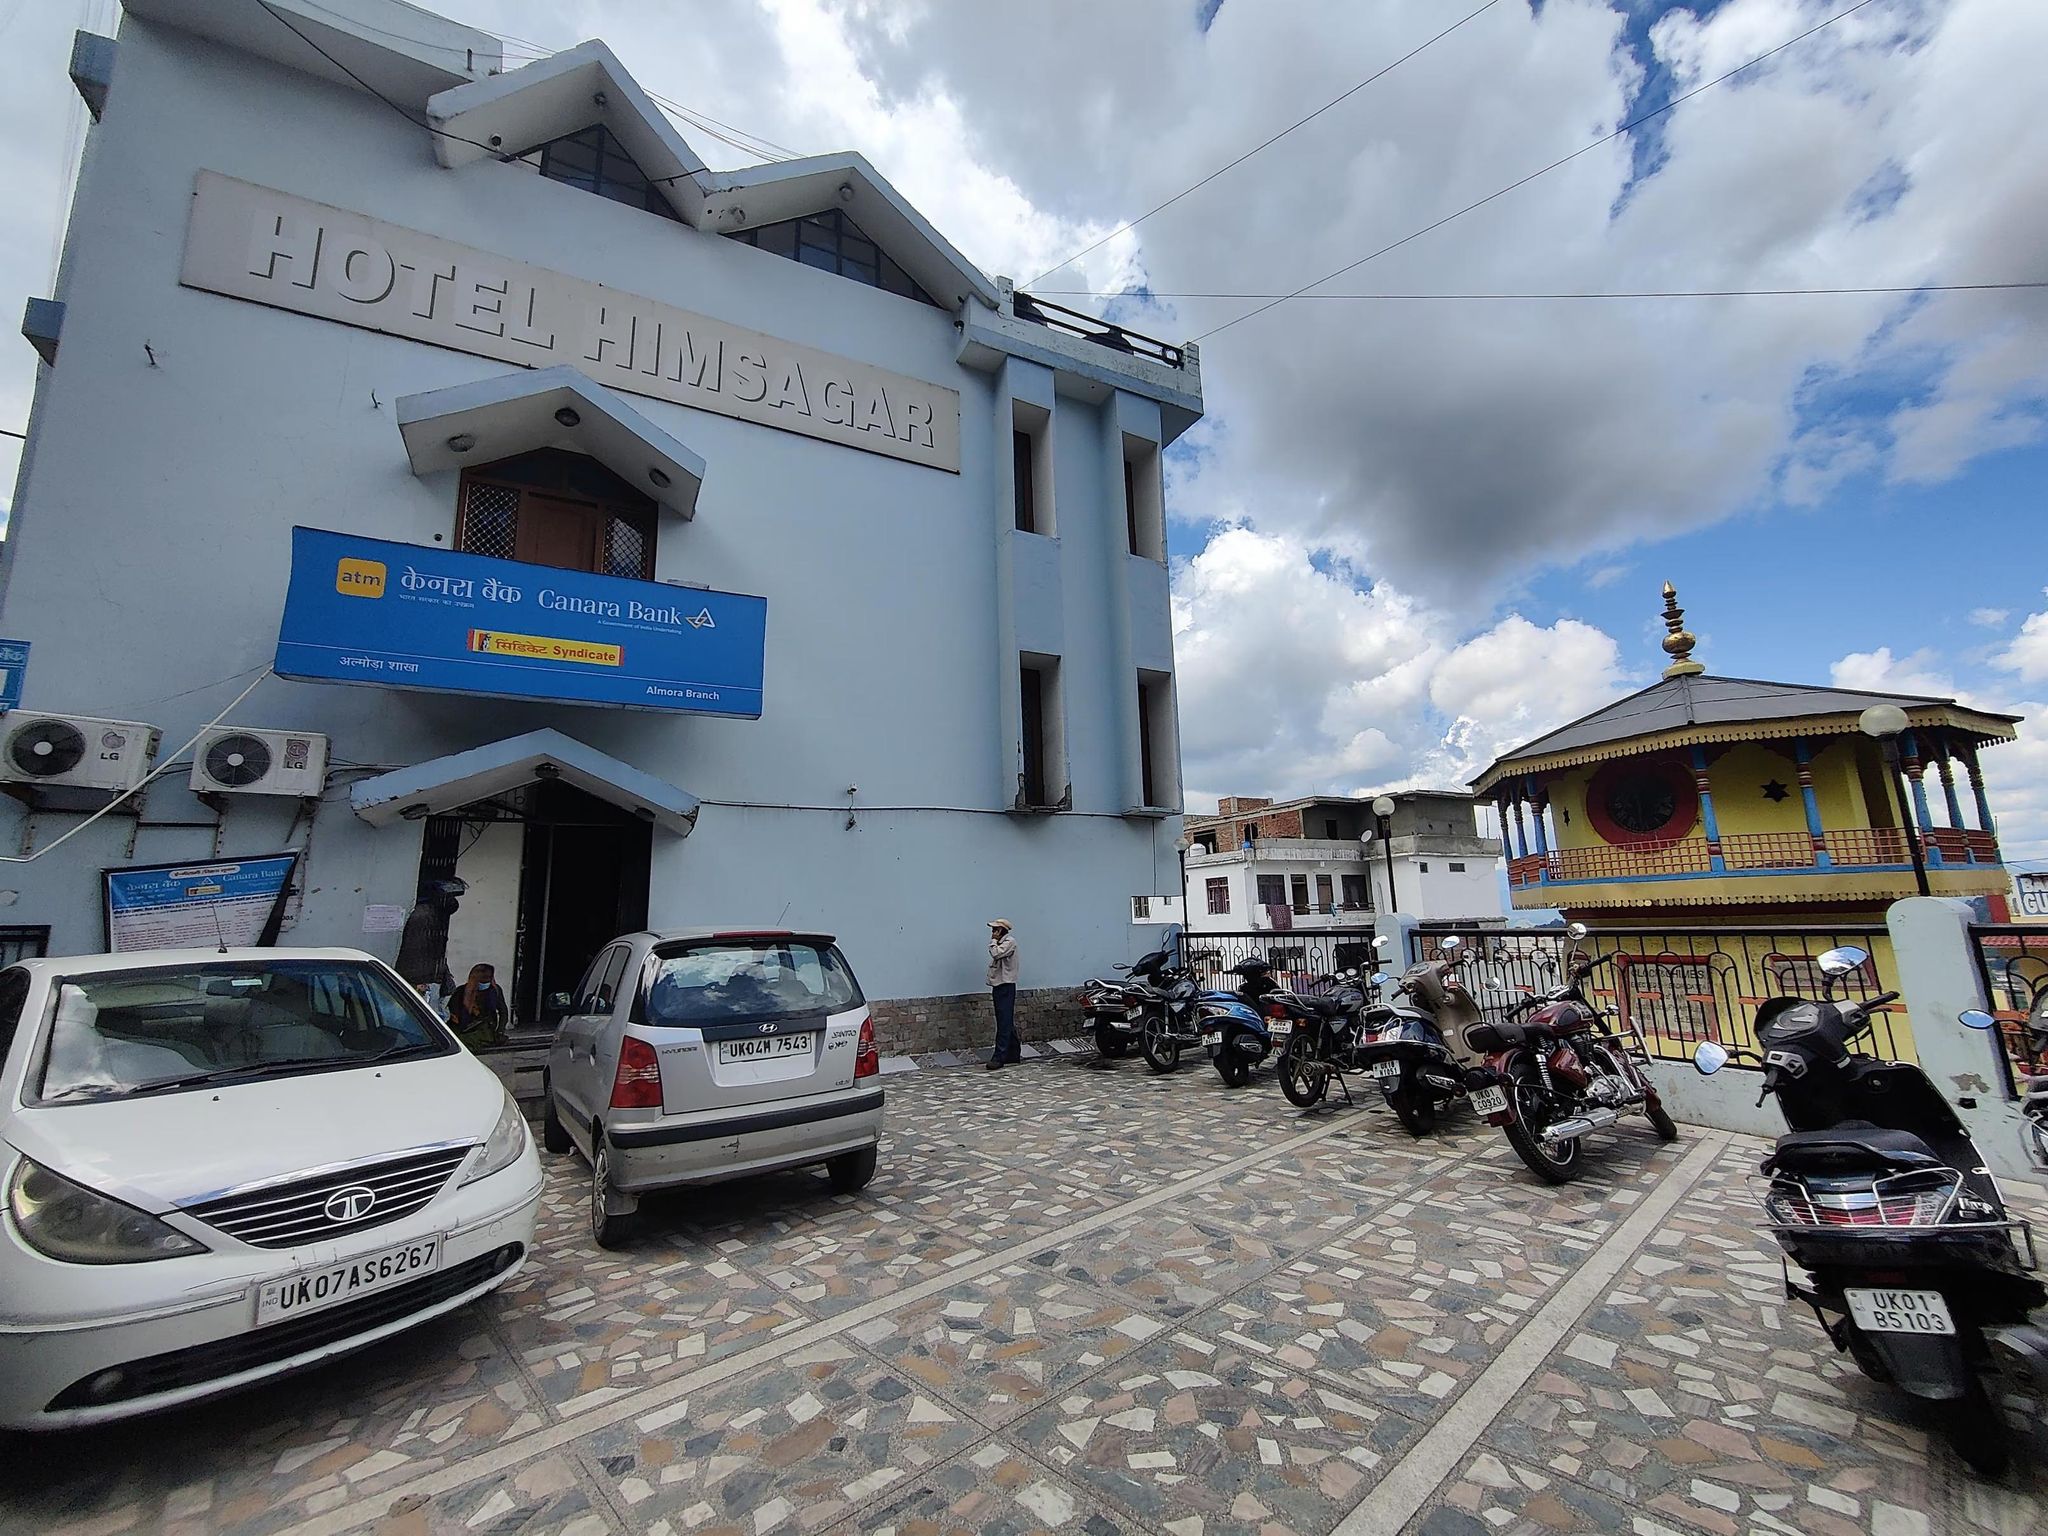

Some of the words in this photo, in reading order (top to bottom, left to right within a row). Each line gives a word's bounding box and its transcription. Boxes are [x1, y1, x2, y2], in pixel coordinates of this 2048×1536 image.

[247, 206, 556, 350] HOTEL
[583, 302, 936, 449] HIMSAGAR
[341, 571, 382, 587] atm
[400, 565, 475, 599] केनरा
[481, 577, 522, 604] बैंक
[538, 589, 621, 618] Canara
[627, 600, 682, 625] Bank
[495, 638, 548, 655] सिंडिकेट
[553, 645, 616, 662] Syndicate
[340, 656, 384, 671] अल्मोड़ा
[388, 661, 419, 673] शाखा
[646, 686, 683, 697] Almora
[686, 689, 720, 701] Branch
[101, 752, 120, 761] LG
[287, 761, 304, 769] LG
[222, 872, 258, 883] Canara
[777, 1036, 807, 1052] 7543
[1475, 1089, 1495, 1100] UK01
[1478, 1096, 1502, 1109] C0920
[280, 1242, 436, 1308] UK07AS6267
[261, 1297, 278, 1307] IND
[1872, 1292, 1930, 1312] UK01
[1873, 1311, 1946, 1332] B5103
